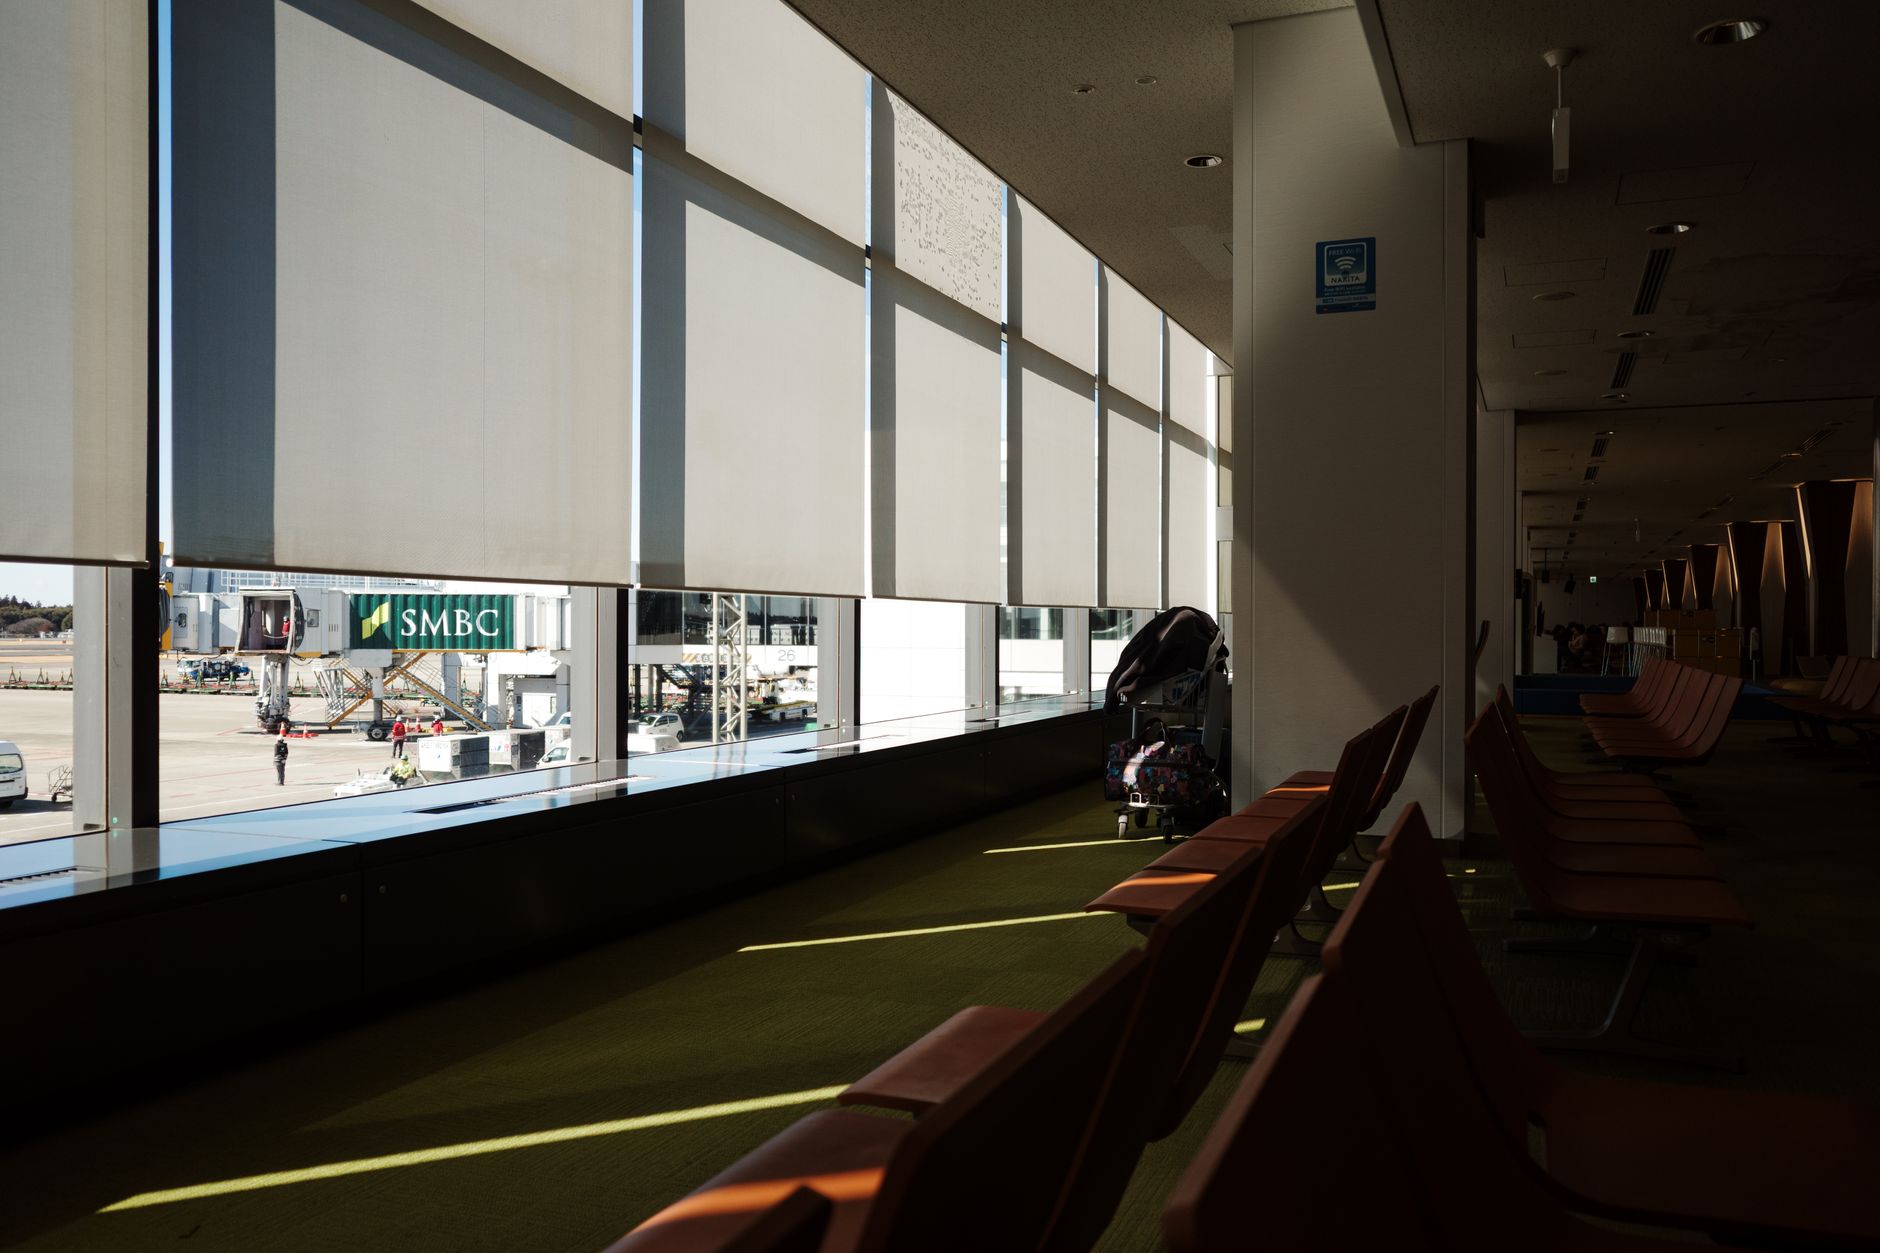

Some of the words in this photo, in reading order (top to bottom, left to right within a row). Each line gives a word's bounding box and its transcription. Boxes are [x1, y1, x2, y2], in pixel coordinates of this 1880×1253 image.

[1328, 248, 1343, 256] FREE
[1331, 275, 1360, 283] NARITA
[400, 608, 499, 637] SMBC
[777, 649, 796, 662] 26
